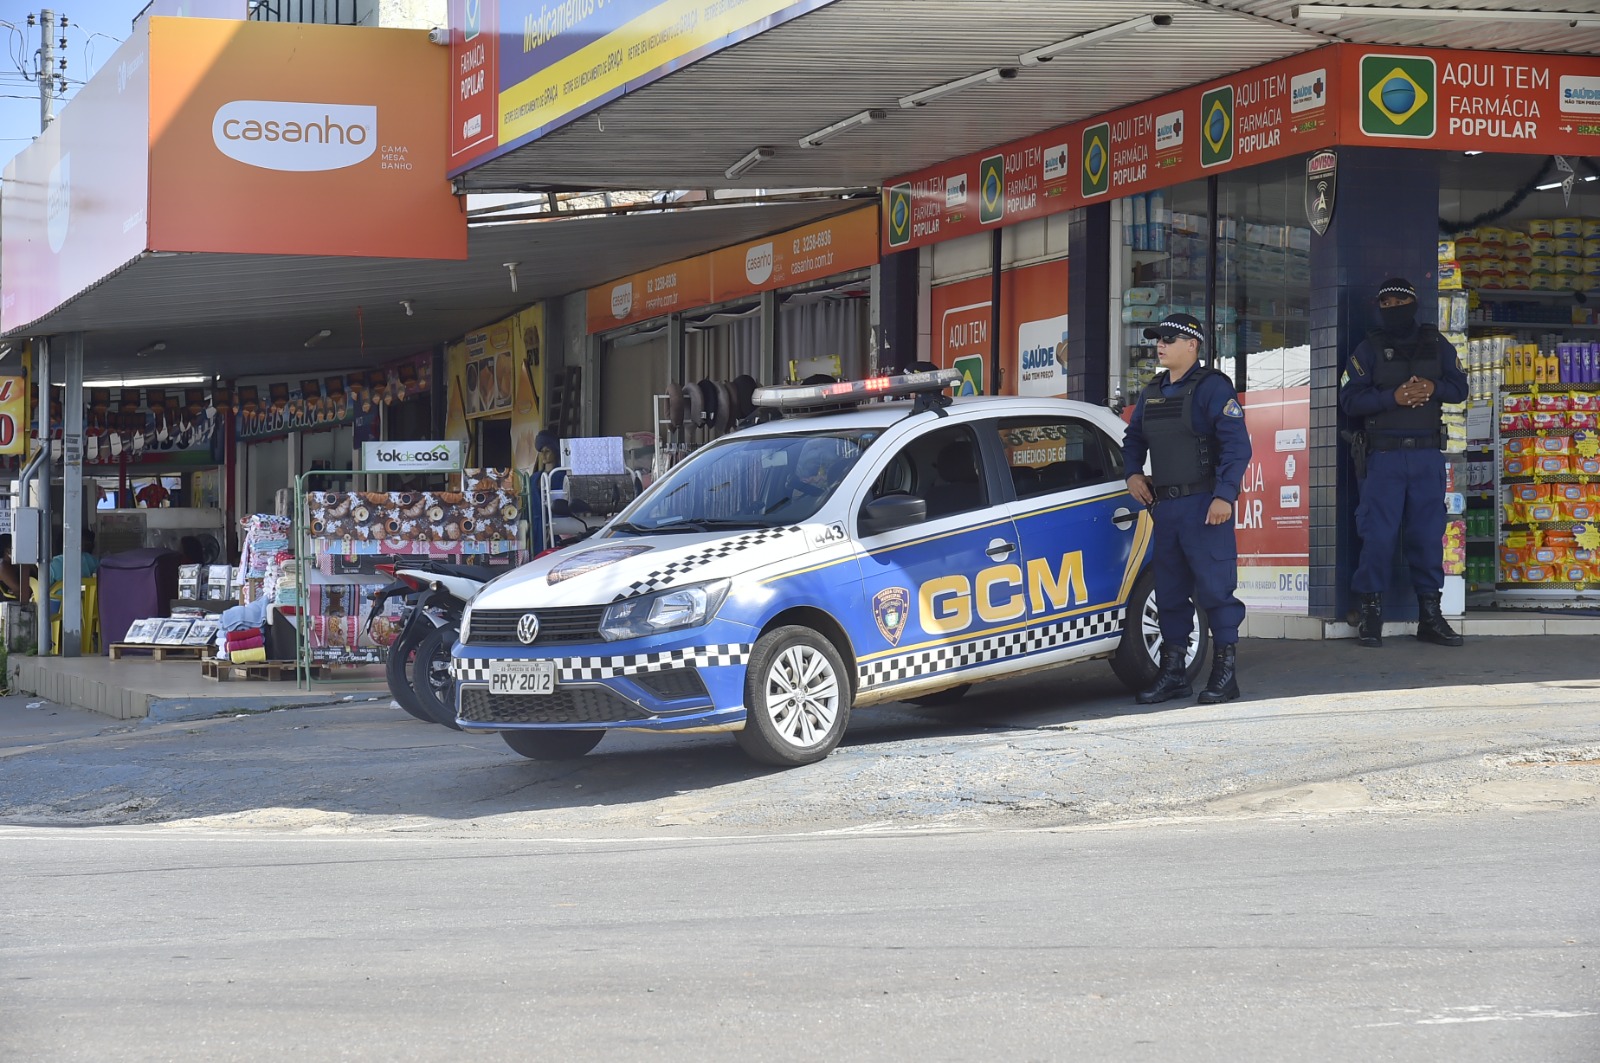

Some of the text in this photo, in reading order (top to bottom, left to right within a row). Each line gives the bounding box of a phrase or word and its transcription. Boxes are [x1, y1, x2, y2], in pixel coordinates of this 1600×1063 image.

[523, 0, 594, 53] Medicamentos
[461, 42, 485, 75] FARMÁCIA
[607, 48, 623, 72] GRAÇA
[461, 69, 485, 101] POPULAR
[1442, 63, 1549, 90] AQUI TEM
[544, 84, 558, 106] GRAÇA
[1235, 73, 1287, 108] AQUI TEM
[1450, 95, 1541, 118] FARMÁCIA
[222, 114, 366, 145] casanho
[1111, 113, 1152, 144] AQUI TEM
[1239, 106, 1282, 134] FARMÁCIA
[1449, 118, 1537, 139] POPULAR
[381, 145, 408, 153] CAMA
[1239, 129, 1281, 155] POPULAR
[381, 154, 405, 162] MESA
[381, 162, 413, 171] BANHO
[1005, 146, 1041, 174] AQUI TEM
[1113, 142, 1148, 167] FARMÁCIA
[1007, 173, 1038, 197] FARMÁCIA
[1113, 164, 1147, 187] POPULAR
[912, 175, 944, 201] AQUI TEM
[913, 201, 941, 221] FARMÁCIA
[1007, 193, 1037, 214] POPULAR
[913, 218, 940, 238] POPULAR
[747, 250, 771, 271] casanho
[791, 250, 834, 275] casanho.com.br
[949, 320, 987, 350] AQUI TEM
[1022, 344, 1054, 371] SAÚDE
[1022, 370, 1054, 381] NÃO TEM PREÇO
[1013, 446, 1046, 465] REMÉDIOS
[1047, 448, 1056, 462] DE
[918, 550, 1088, 635] GCM
[1279, 573, 1292, 592] DE
